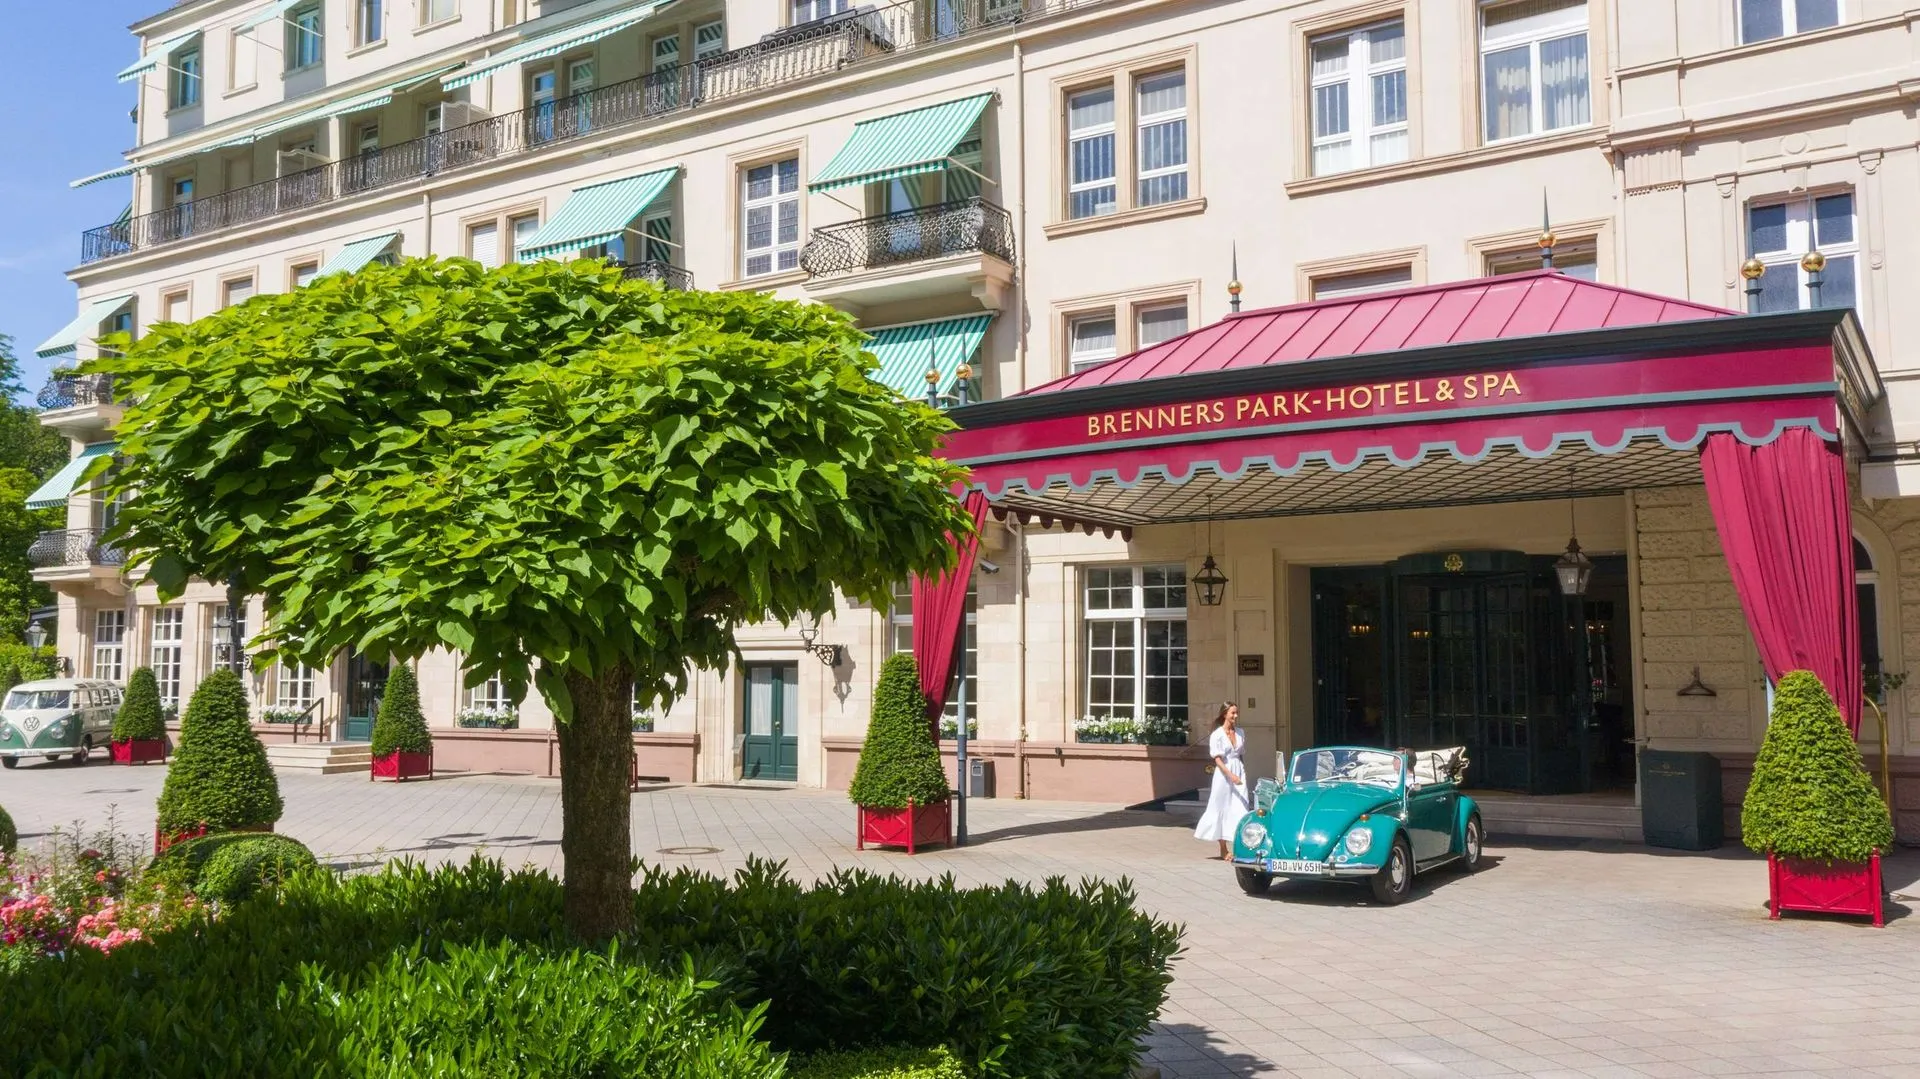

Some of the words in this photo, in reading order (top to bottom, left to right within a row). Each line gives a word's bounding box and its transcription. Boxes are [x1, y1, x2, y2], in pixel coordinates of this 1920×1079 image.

[1088, 401, 1225, 436] BRENNERS
[1236, 381, 1430, 420] PARK-HOTEL
[1435, 379, 1455, 401] &
[1464, 372, 1522, 399] SPA
[1272, 861, 1288, 871] BAD
[1292, 862, 1303, 871] VW
[1304, 863, 1321, 873] 65H
